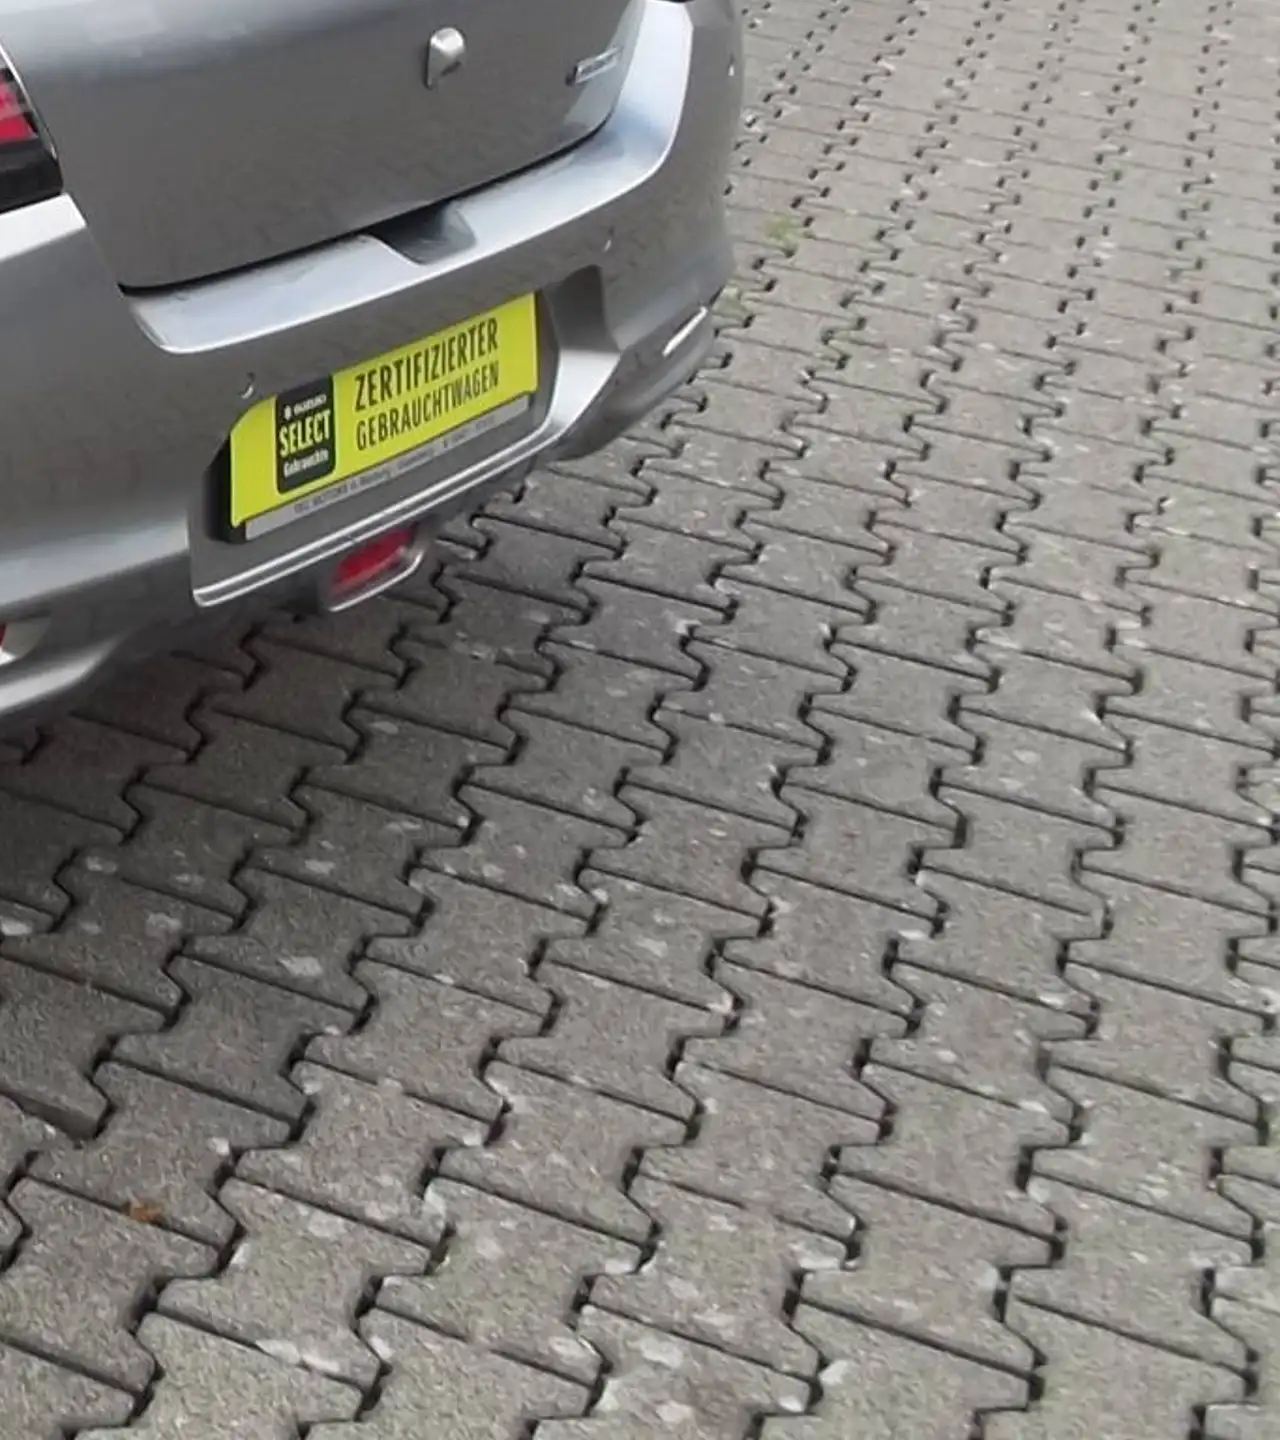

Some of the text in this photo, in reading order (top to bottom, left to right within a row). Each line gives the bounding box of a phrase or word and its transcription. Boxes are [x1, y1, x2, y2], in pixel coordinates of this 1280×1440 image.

[355, 317, 498, 412] ZERTIFIZIERTER
[356, 361, 500, 451] GEBRAUCHTWAGEN
[280, 409, 331, 458] SELECT
